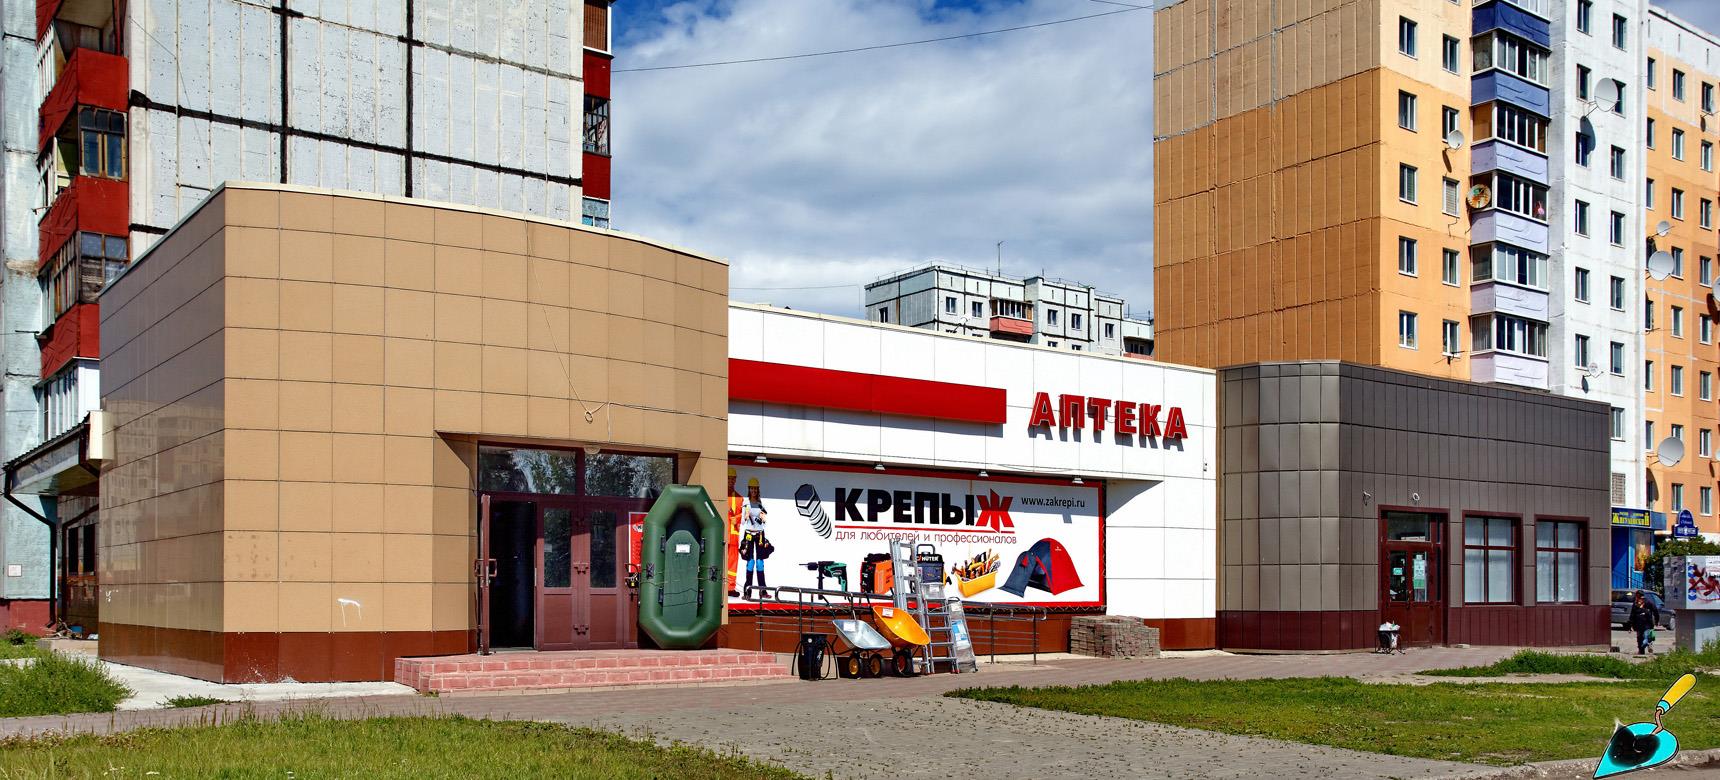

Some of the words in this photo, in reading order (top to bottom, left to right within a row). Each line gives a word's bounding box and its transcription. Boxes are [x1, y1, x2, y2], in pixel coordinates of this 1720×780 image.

[1027, 391, 1188, 439] АПТЕКА
[834, 487, 1015, 533] КРЕПЫЖ
[1021, 496, 1085, 509] www.zakrepi.ru
[835, 531, 856, 541] для
[860, 530, 920, 542] любителей
[924, 534, 931, 542] и
[935, 533, 1017, 546] профессионалов
